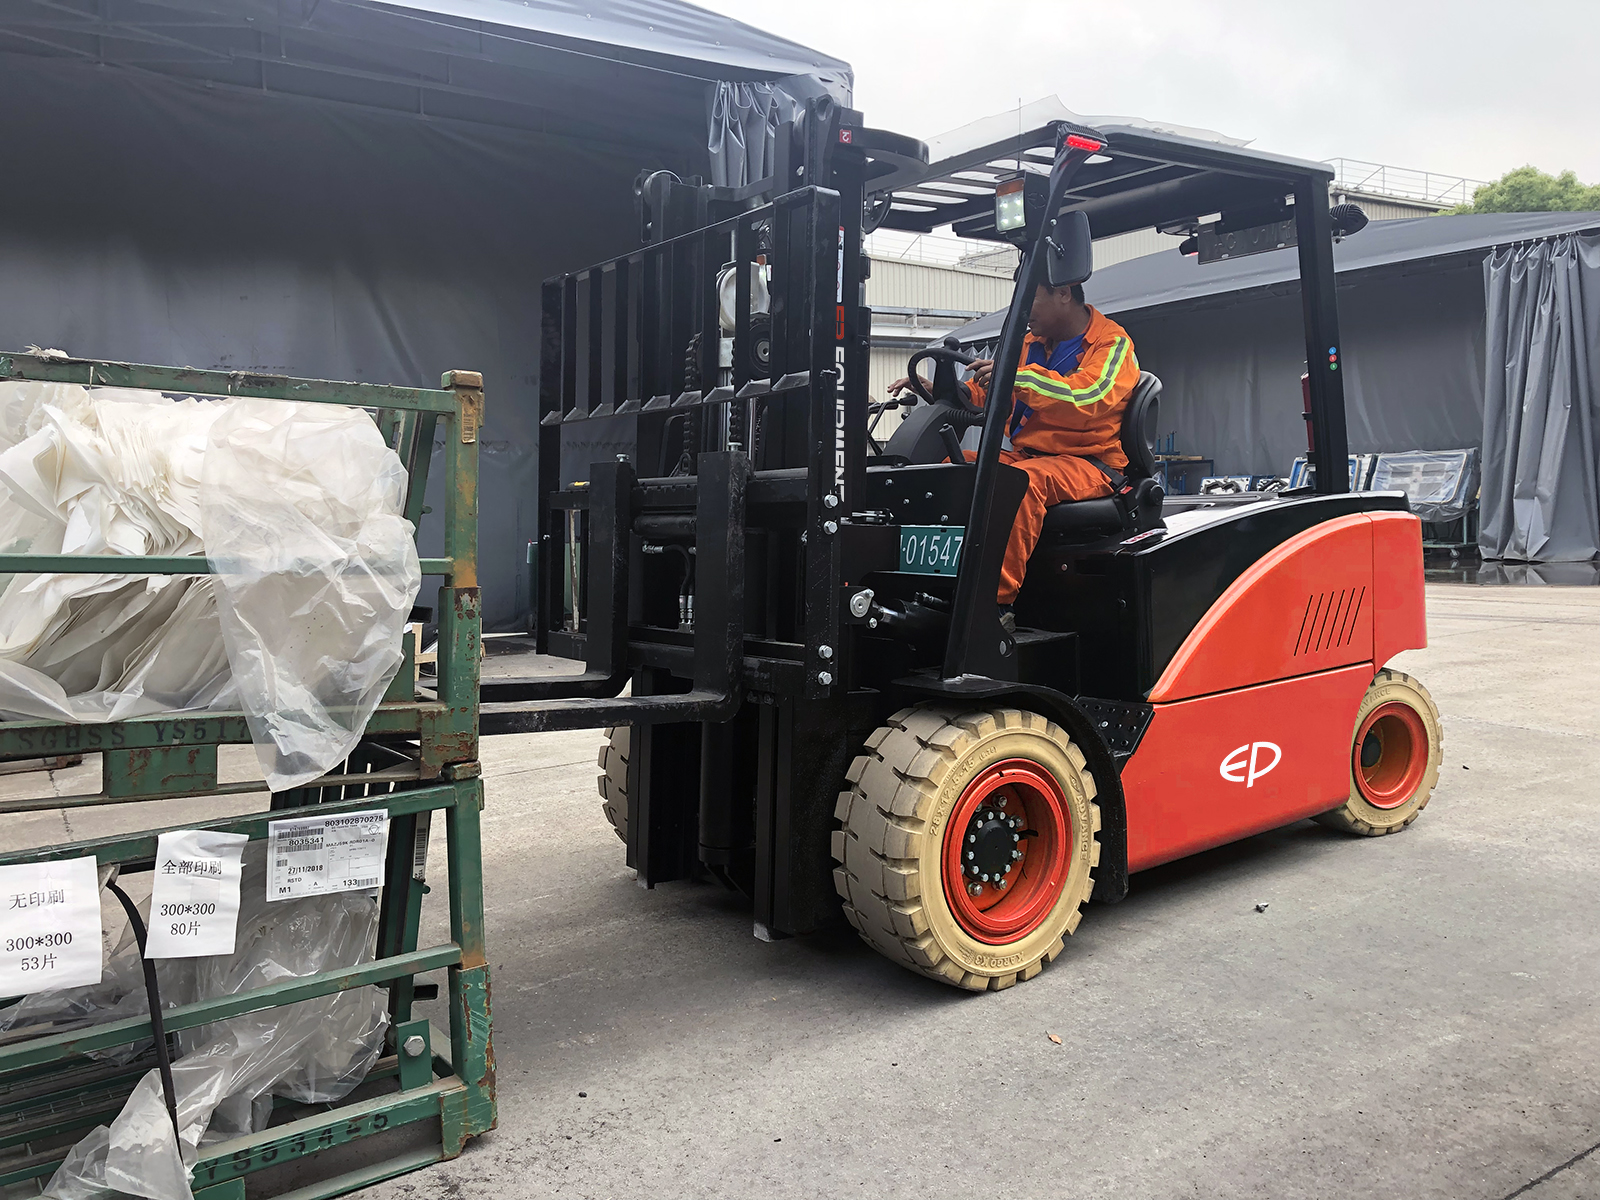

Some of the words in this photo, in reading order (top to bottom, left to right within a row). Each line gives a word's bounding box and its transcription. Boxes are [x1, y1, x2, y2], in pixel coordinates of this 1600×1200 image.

[1219, 741, 1282, 788] EP
[325, 815, 384, 827] 803102870275
[288, 837, 324, 847] 8035341
[162, 859, 222, 875] 全部印刷
[287, 865, 324, 875] 27/11/2018
[343, 879, 358, 887] 133
[279, 886, 291, 894] M1
[9, 889, 65, 911] 无印刷
[170, 921, 201, 936] 80片
[21, 953, 57, 972] 53片
